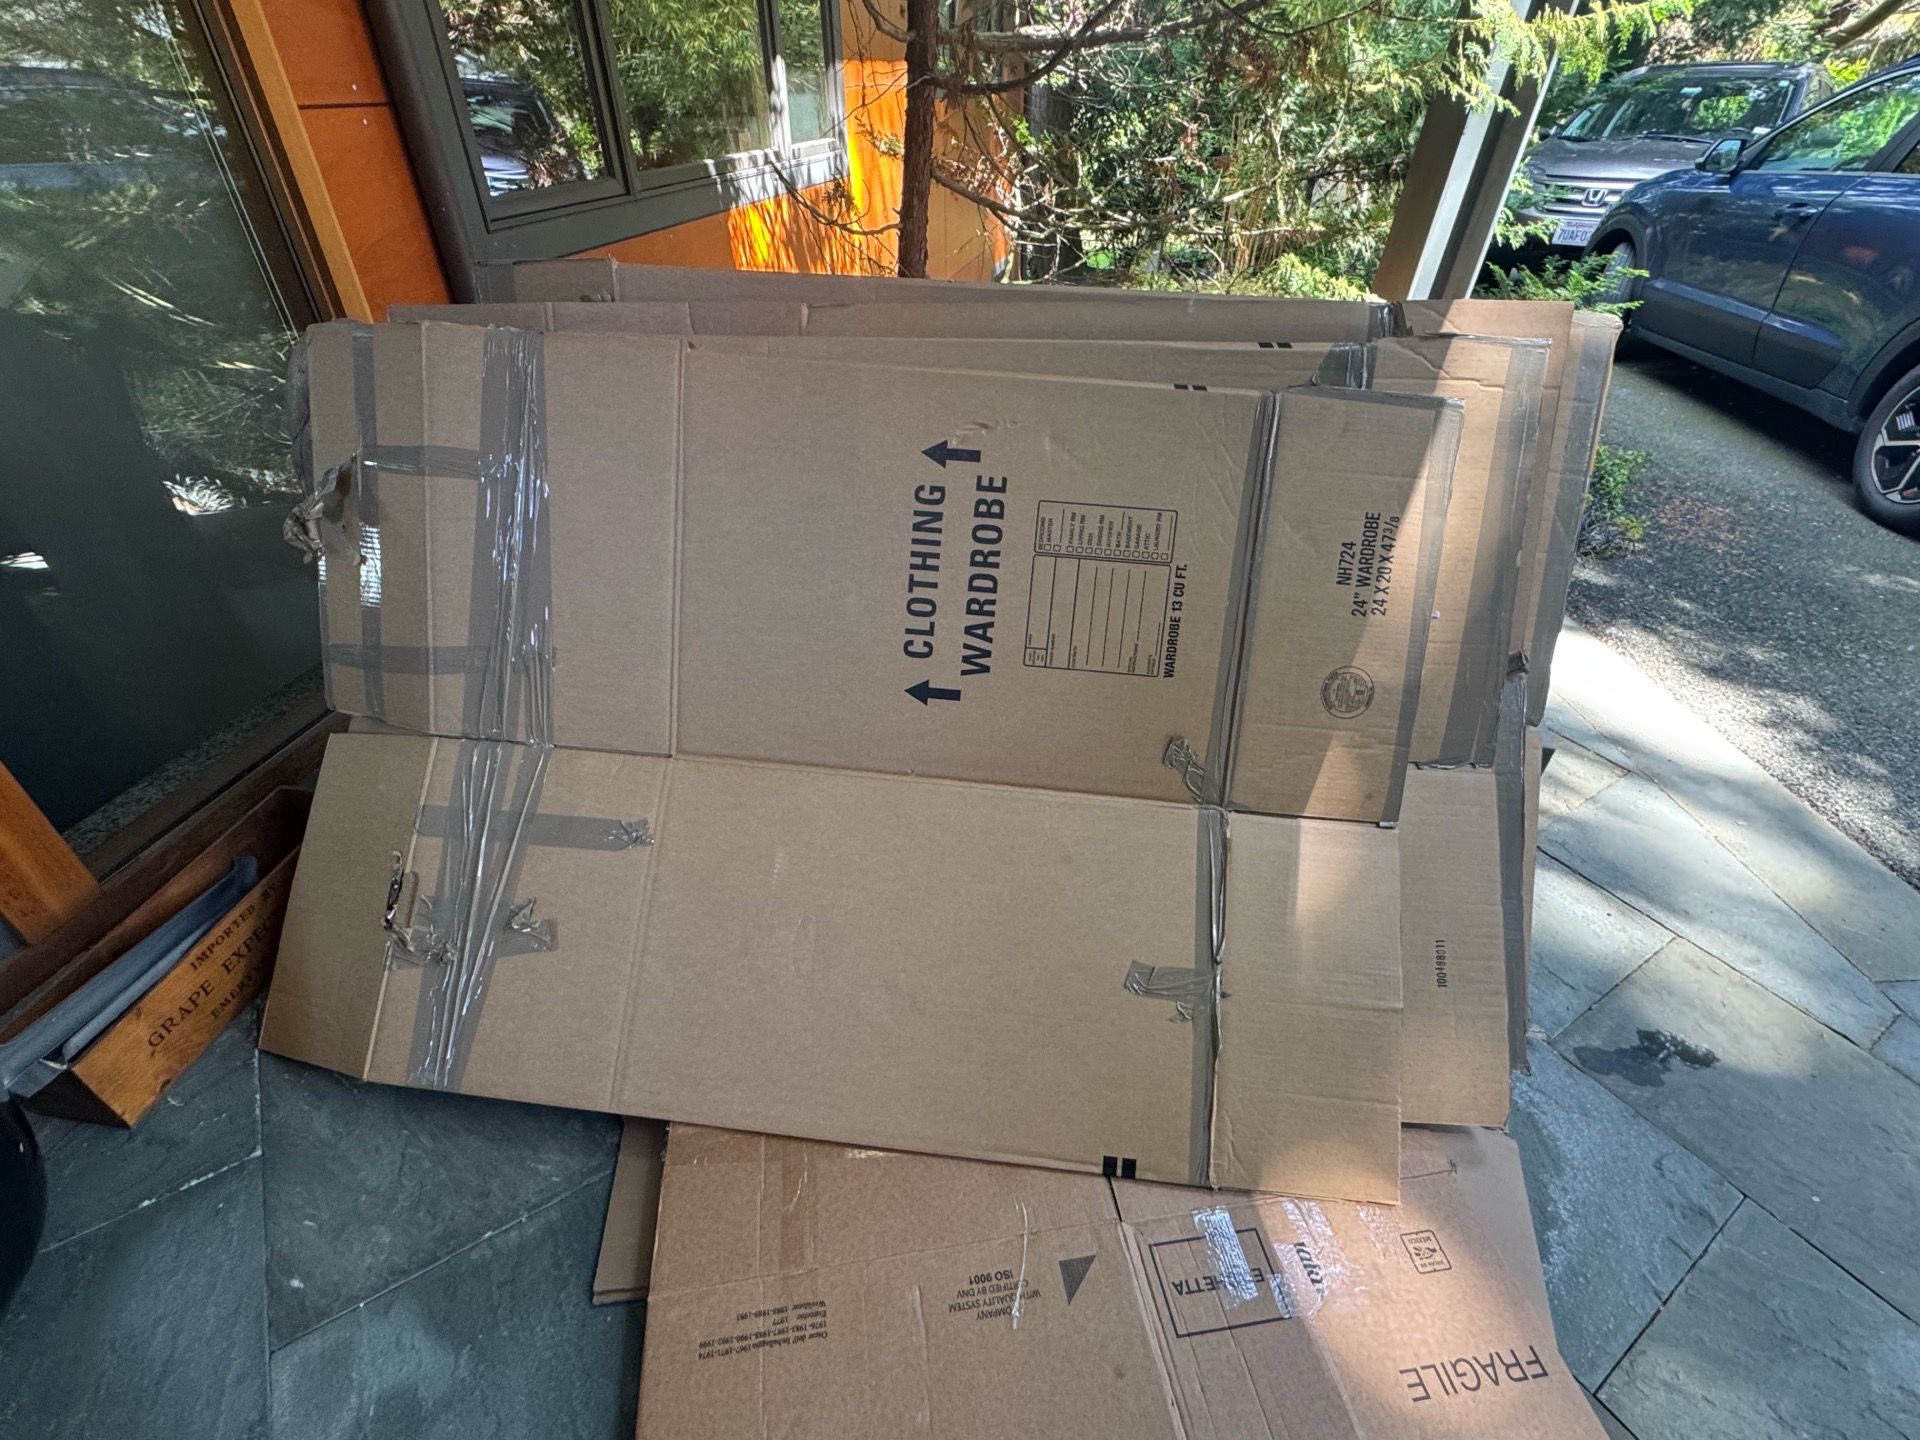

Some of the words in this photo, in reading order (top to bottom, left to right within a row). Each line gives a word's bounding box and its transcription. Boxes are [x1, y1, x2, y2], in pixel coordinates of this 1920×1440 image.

[1071, 512, 1076, 522] RM
[1080, 514, 1086, 524] RM
[1099, 514, 1105, 524] RM
[1156, 512, 1162, 522] RM
[1038, 517, 1046, 550] BEDROOMS
[1106, 521, 1114, 547] KITCHEN
[1125, 516, 1133, 548] BASEMENT
[1134, 524, 1142, 549] GARAGE
[1153, 523, 1161, 551] LAUNDRY
[1356, 512, 1381, 587] WARDROBE
[1336, 542, 1356, 586] NH724
[903, 484, 946, 659] CLOTHING
[961, 475, 1007, 676] WARDROBE
[1175, 564, 1187, 579] FT.
[1377, 567, 1392, 583] 20
[1172, 583, 1184, 597] CU
[1374, 586, 1389, 595] X
[1171, 602, 1182, 612] 13
[1372, 599, 1388, 616] 24
[1163, 617, 1181, 678] WARDROBE
[190, 904, 256, 971] IMPORTED
[262, 882, 279, 900] BY
[148, 979, 216, 1048] GRAPE
[221, 911, 282, 974] EXPEC
[969, 1273, 992, 1285] 9001
[995, 1269, 1013, 1281] ISO
[1172, 1268, 1265, 1296] EHETTA
[976, 1286, 987, 1295] BY
[989, 1279, 1029, 1293] CRTIFIED
[956, 1289, 974, 1298] DNV
[983, 1293, 1016, 1307] QUALITY
[948, 1299, 980, 1312] SYSTEM
[797, 1310, 827, 1321] Eurostar
[976, 1306, 1012, 1320] OMPANY
[773, 1316, 788, 1325] 1977
[808, 1330, 828, 1341] Oscar
[1399, 1346, 1549, 1403] FRAGILE
